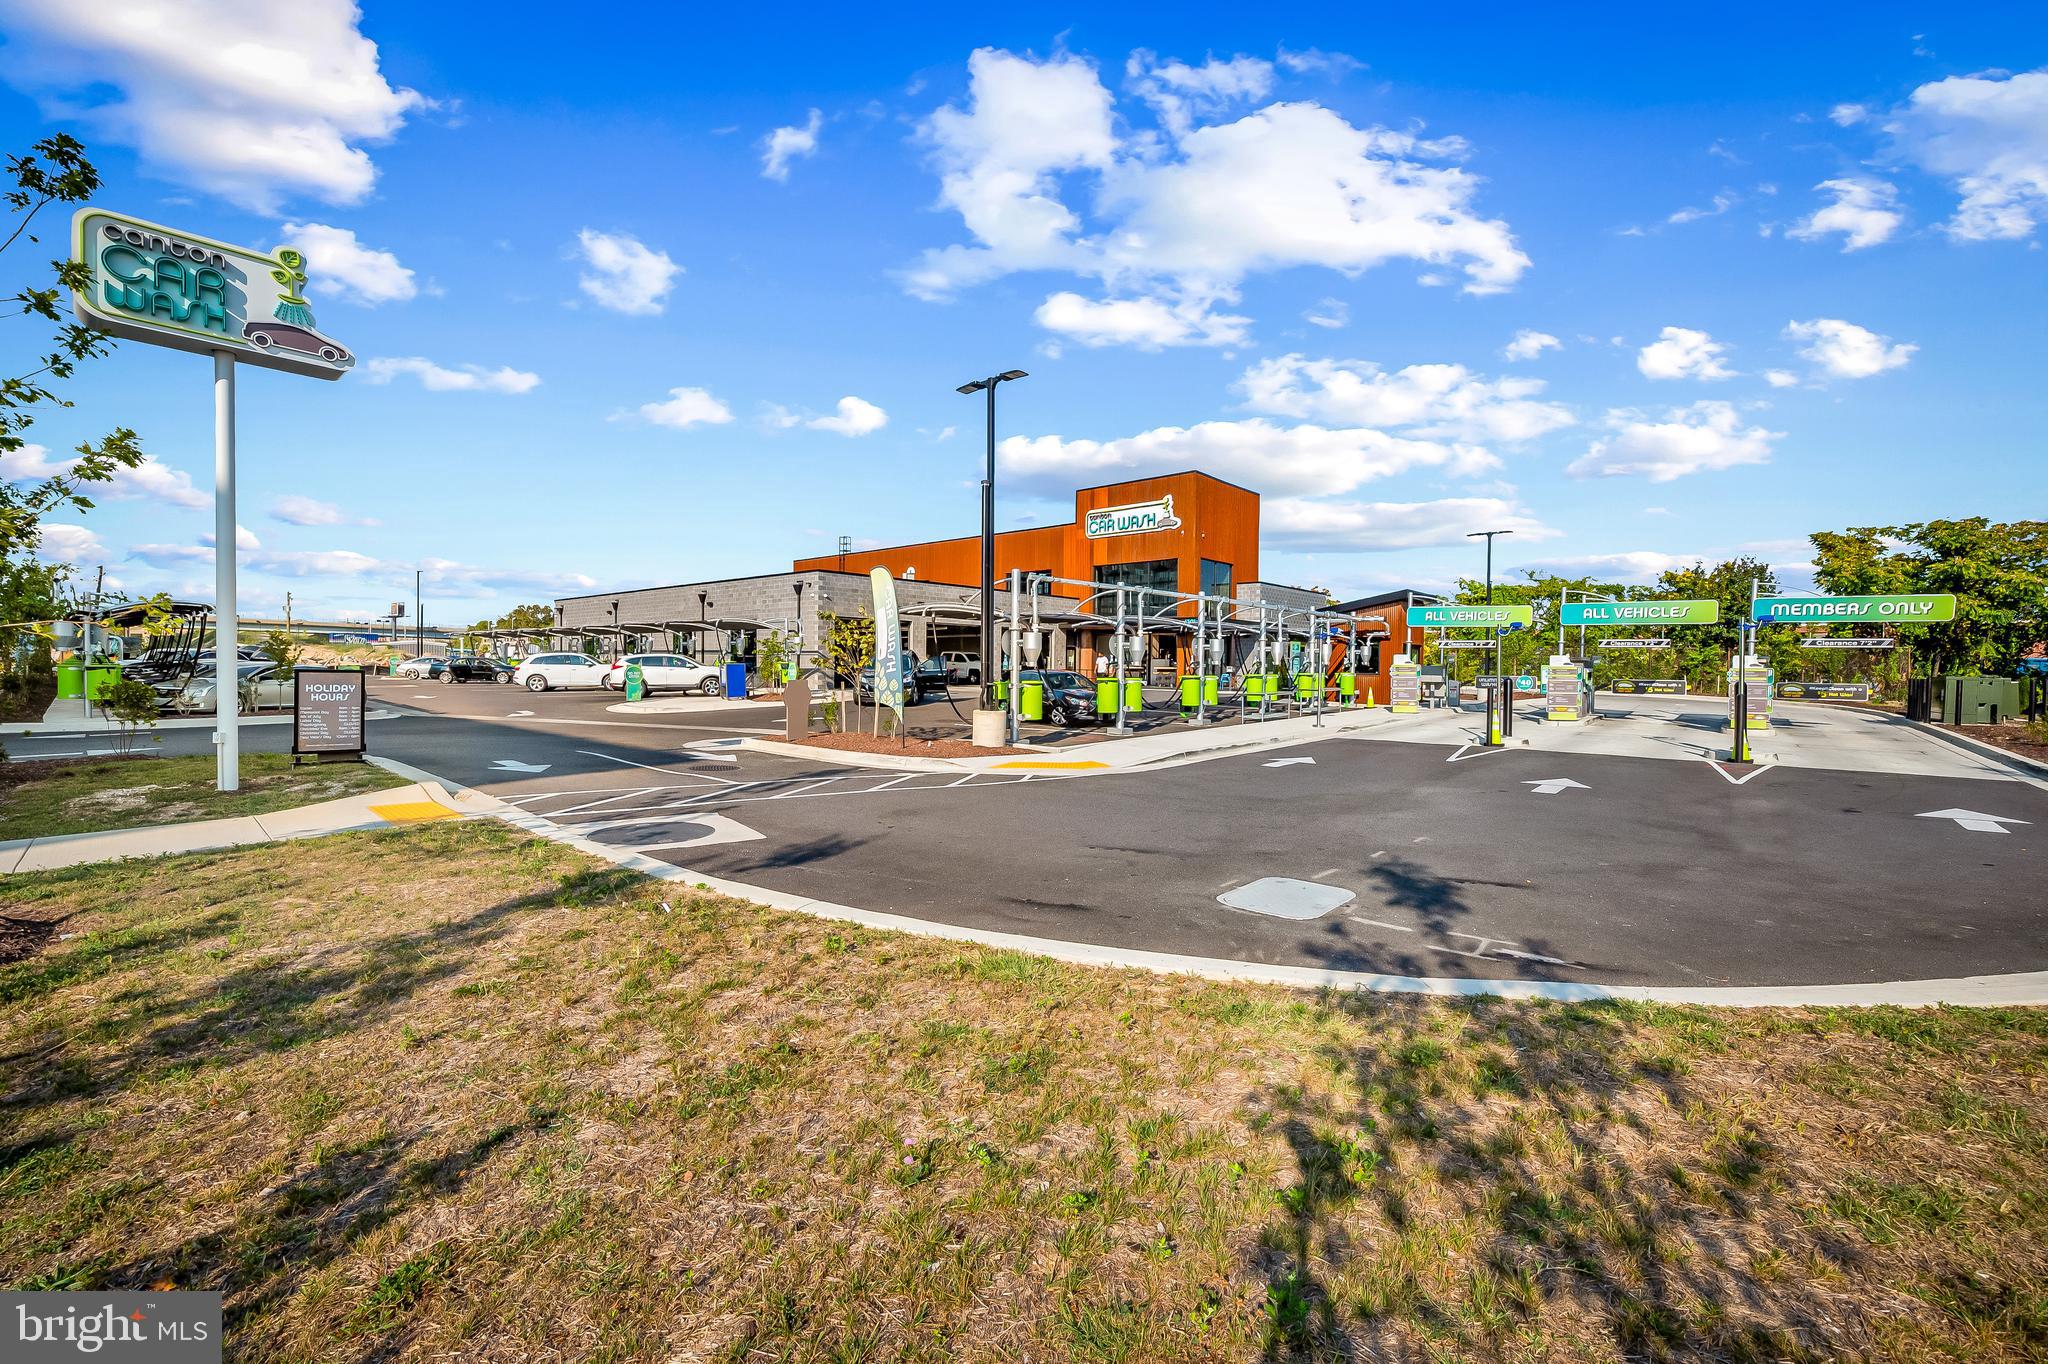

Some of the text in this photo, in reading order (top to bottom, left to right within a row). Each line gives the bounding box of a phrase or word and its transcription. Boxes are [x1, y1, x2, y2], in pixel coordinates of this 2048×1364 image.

[102, 223, 226, 270] canton
[101, 244, 226, 305] CAR
[103, 279, 227, 332] WASH
[1089, 512, 1156, 534] CAR WASH
[1425, 611, 1511, 621] ALL VEHICLES
[1583, 606, 1690, 619] ALL VEHICLES
[1770, 602, 1934, 616] MEMBERS ONLY
[884, 586, 897, 673] CAR WASH
[305, 684, 356, 692] HOLIDAY
[311, 693, 350, 701] HOURS
